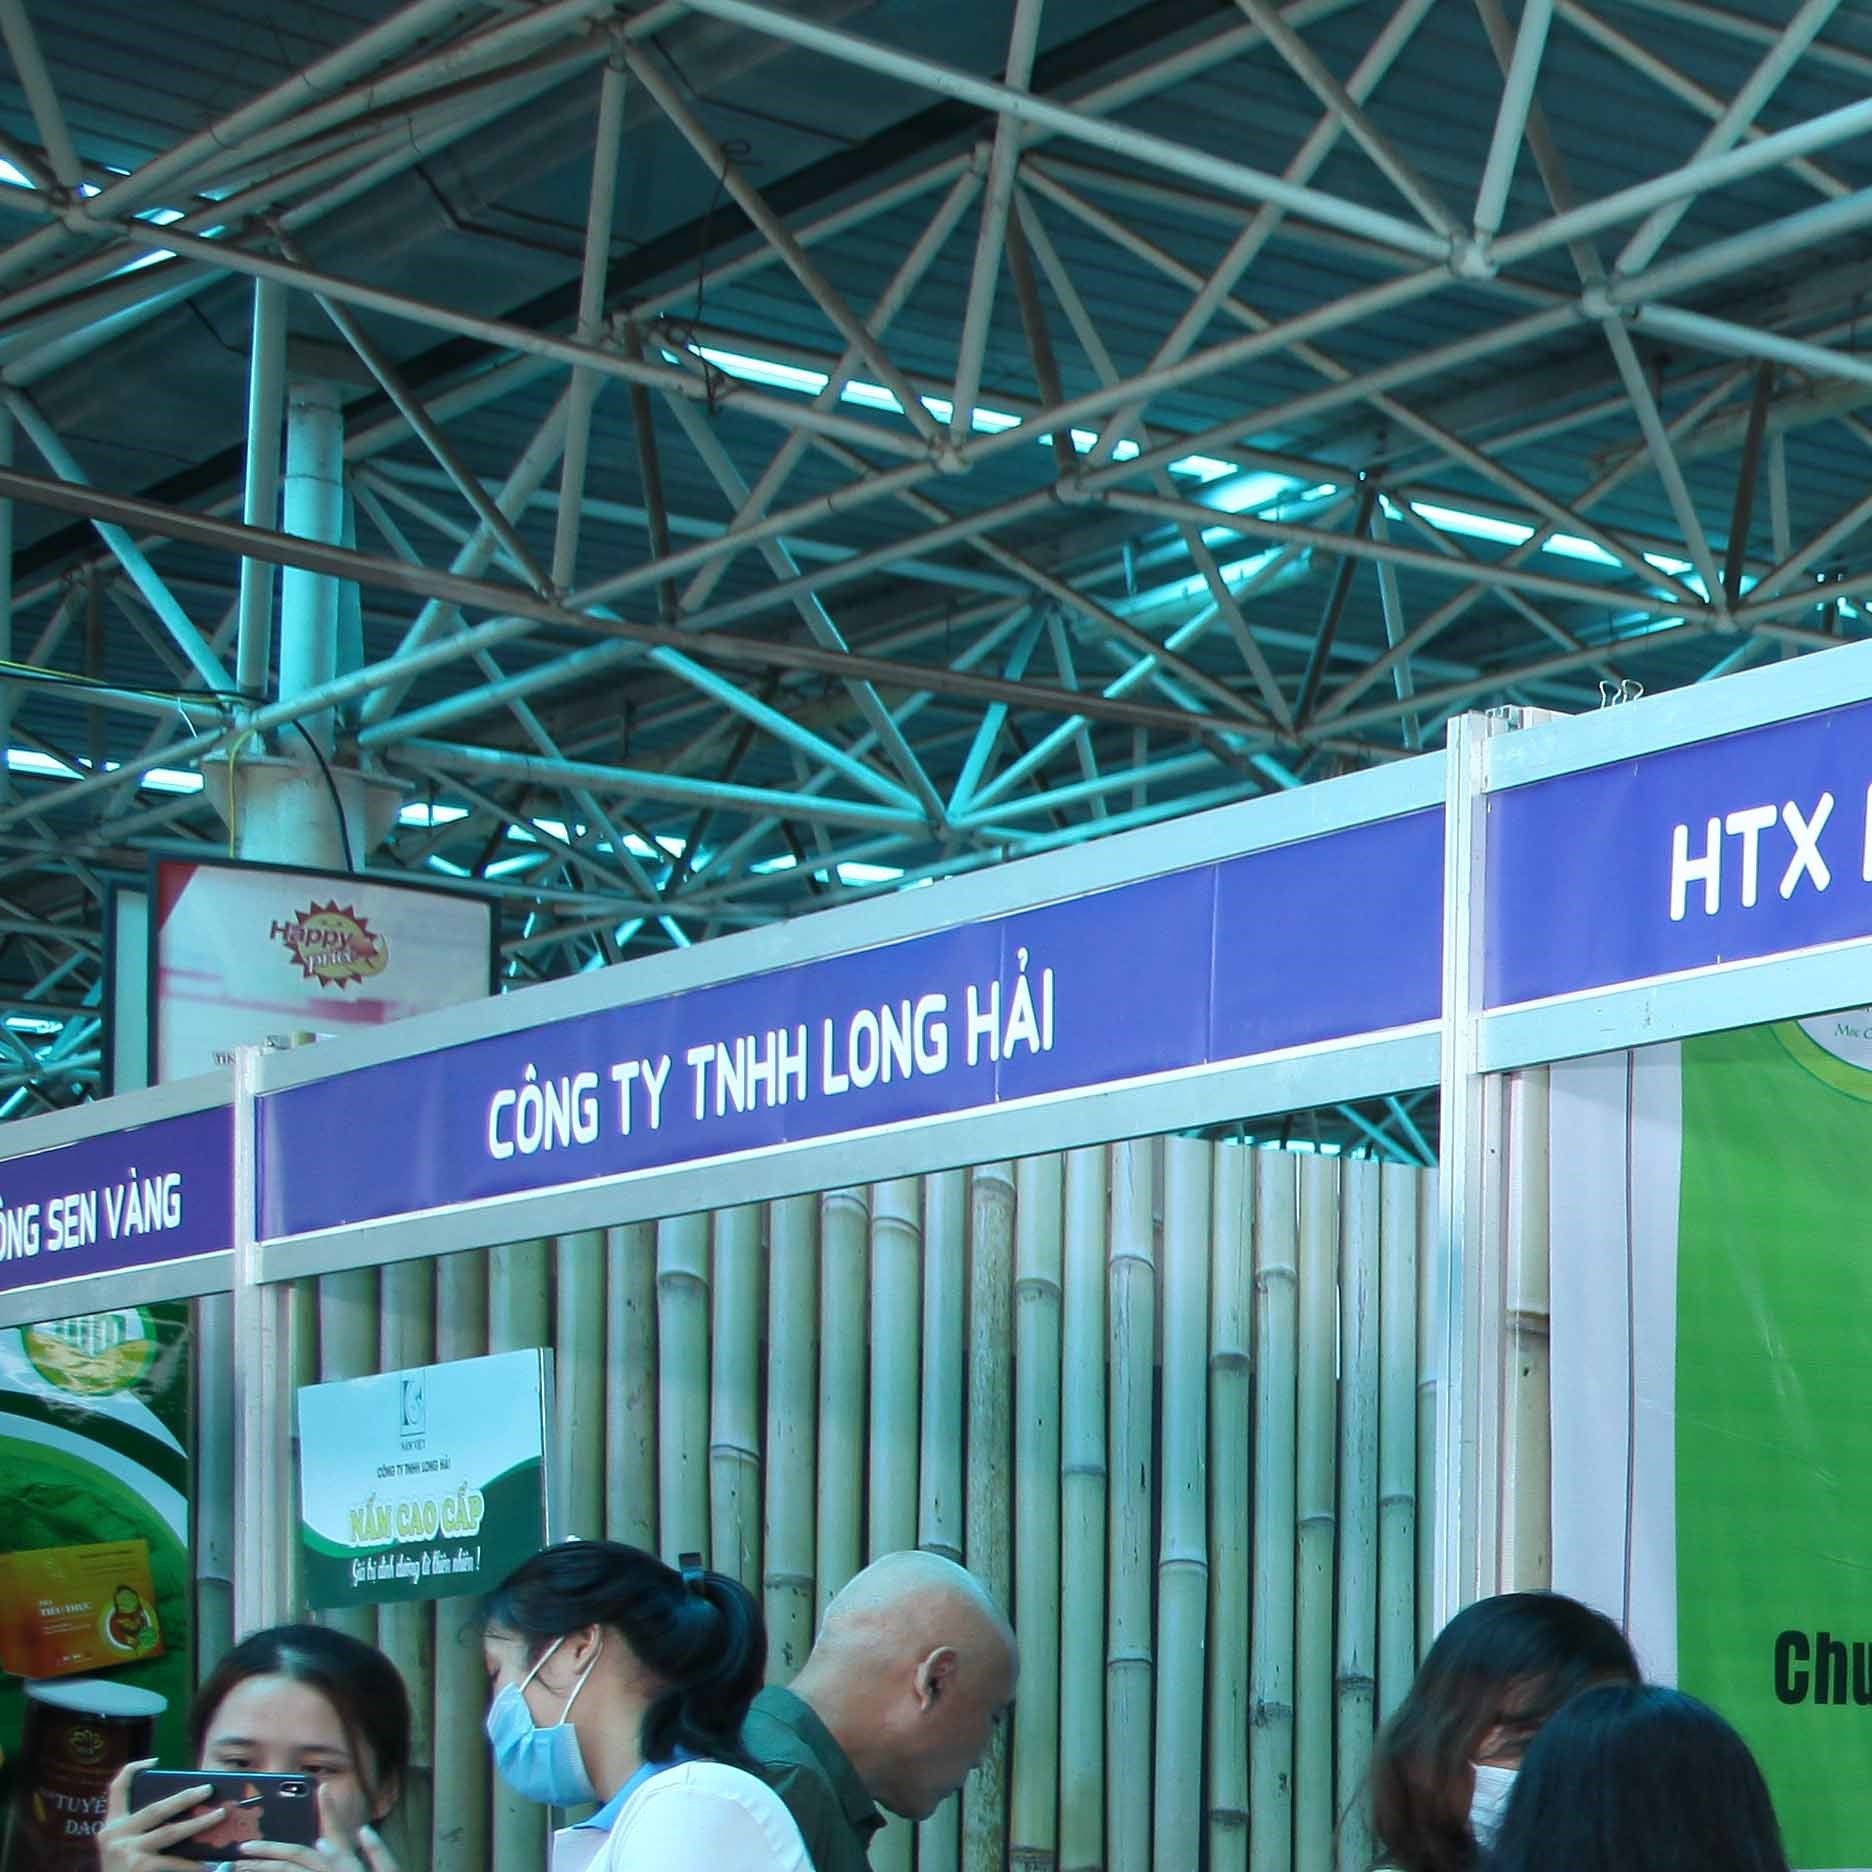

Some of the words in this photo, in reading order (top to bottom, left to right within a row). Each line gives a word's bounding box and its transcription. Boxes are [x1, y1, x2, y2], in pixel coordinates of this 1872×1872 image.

[1668, 793, 1834, 922] HTX
[487, 1062, 598, 1160] CÔNG
[611, 1054, 671, 1135] TY
[687, 1024, 807, 1120] TNHH
[823, 993, 948, 1096] LONG
[966, 947, 1054, 1066] HẢI
[48, 1189, 97, 1252] SEN
[104, 1166, 182, 1240] VÀNG
[397, 1500, 438, 1537] CAO
